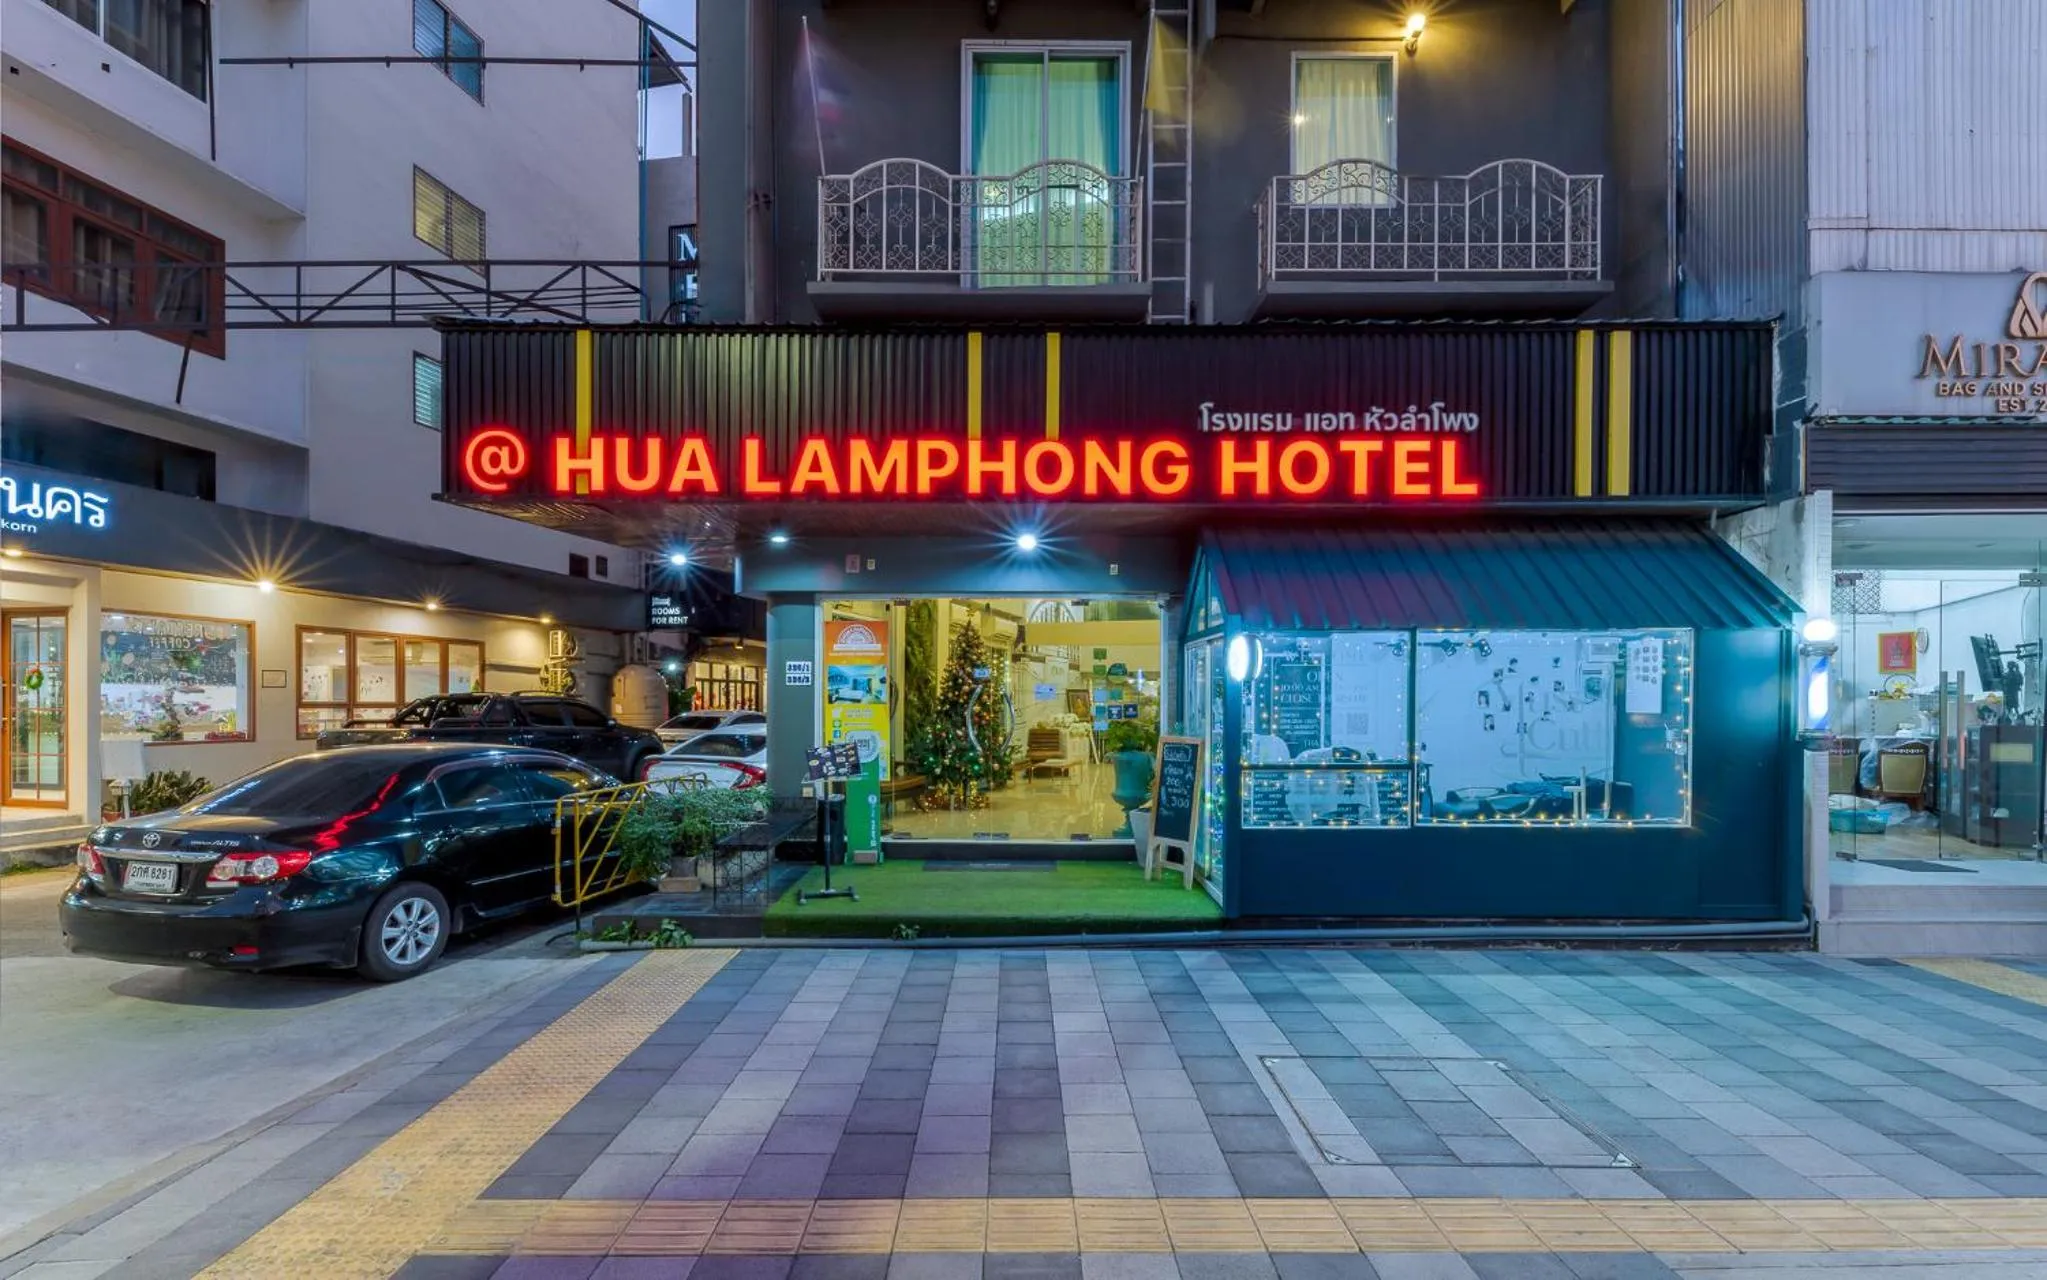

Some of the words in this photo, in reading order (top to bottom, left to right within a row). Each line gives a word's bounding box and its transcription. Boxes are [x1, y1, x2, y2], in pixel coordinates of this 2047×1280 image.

[1938, 381, 1977, 396] BAG
[1985, 381, 2025, 396] AND
[1199, 402, 1292, 431] โรงแรม
[1305, 411, 1354, 431] แอท
[1364, 402, 1479, 431] หัวลำโพง
[465, 430, 525, 491] @
[555, 437, 718, 492] HUA
[744, 438, 1190, 495] LAMPHONG
[1220, 440, 1479, 495] HOTEL
[652, 607, 680, 615] ROOMS
